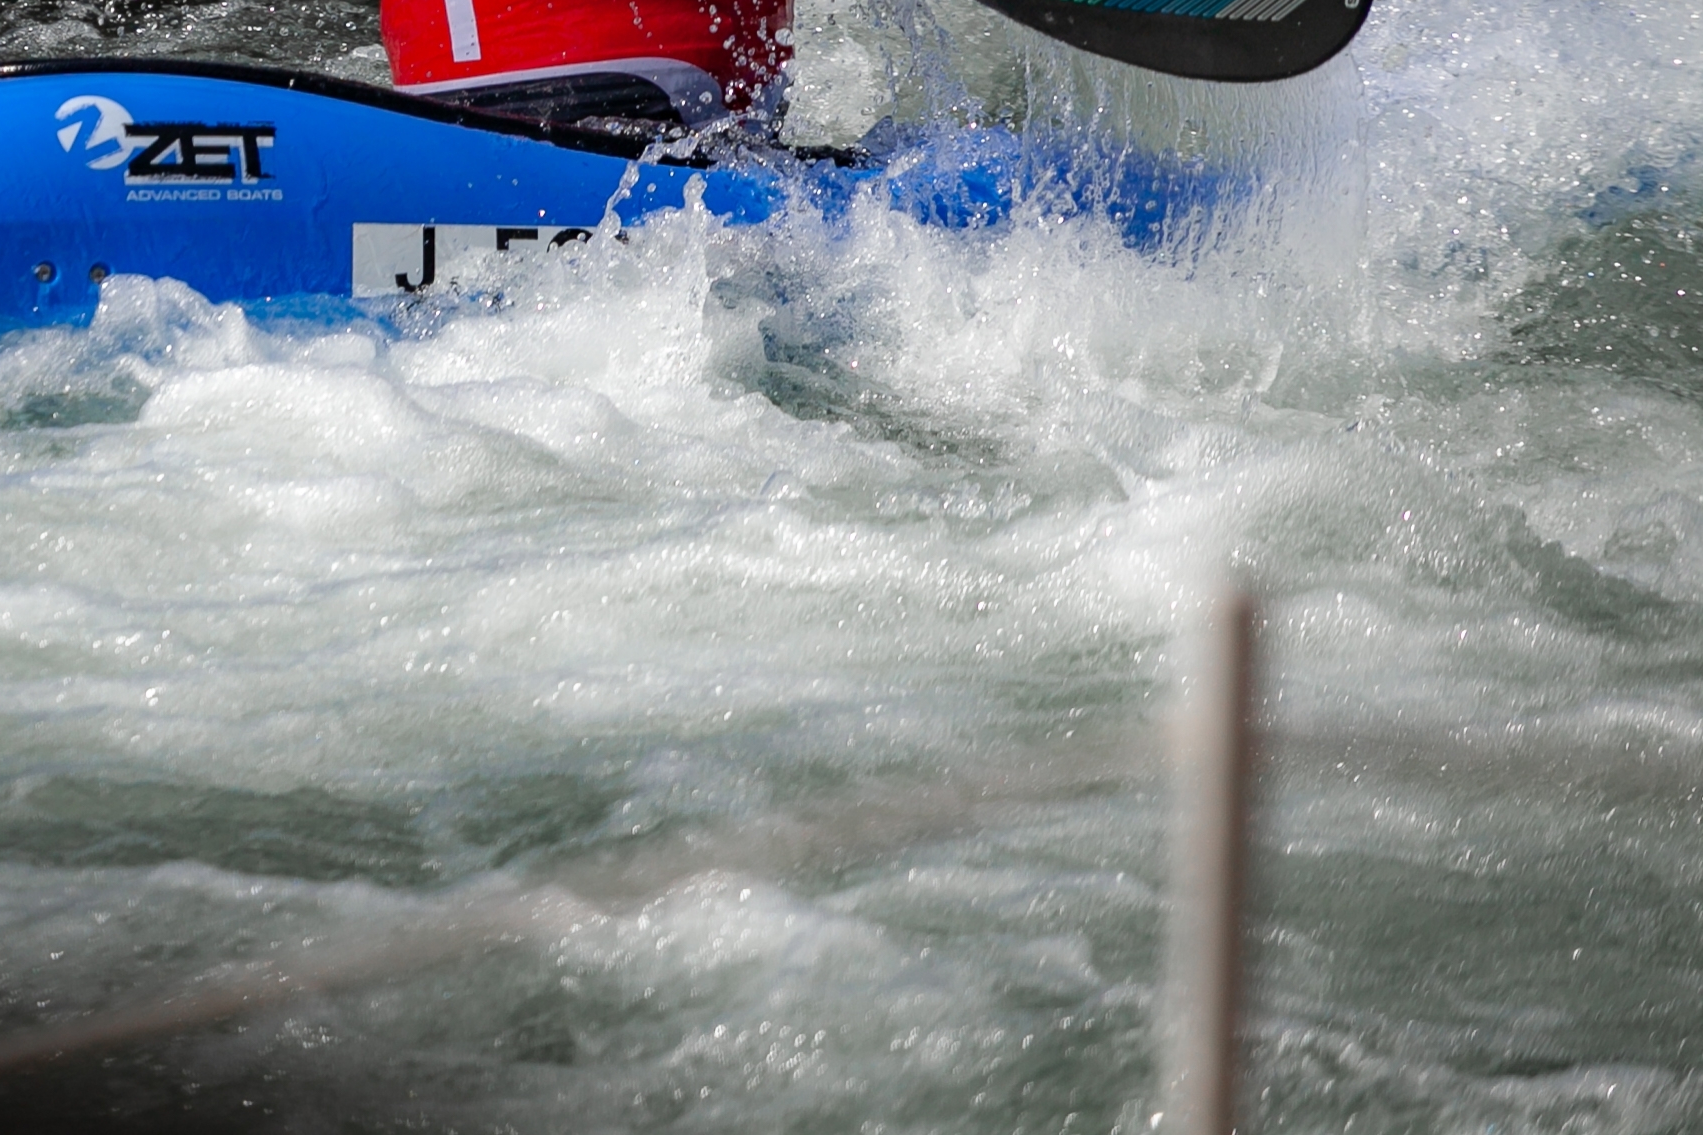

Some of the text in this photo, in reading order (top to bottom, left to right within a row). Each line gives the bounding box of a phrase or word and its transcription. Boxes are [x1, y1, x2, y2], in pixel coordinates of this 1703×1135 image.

[122, 121, 277, 185] ZET
[126, 188, 284, 202] ADVANCED BOATS
[395, 226, 435, 292] J
